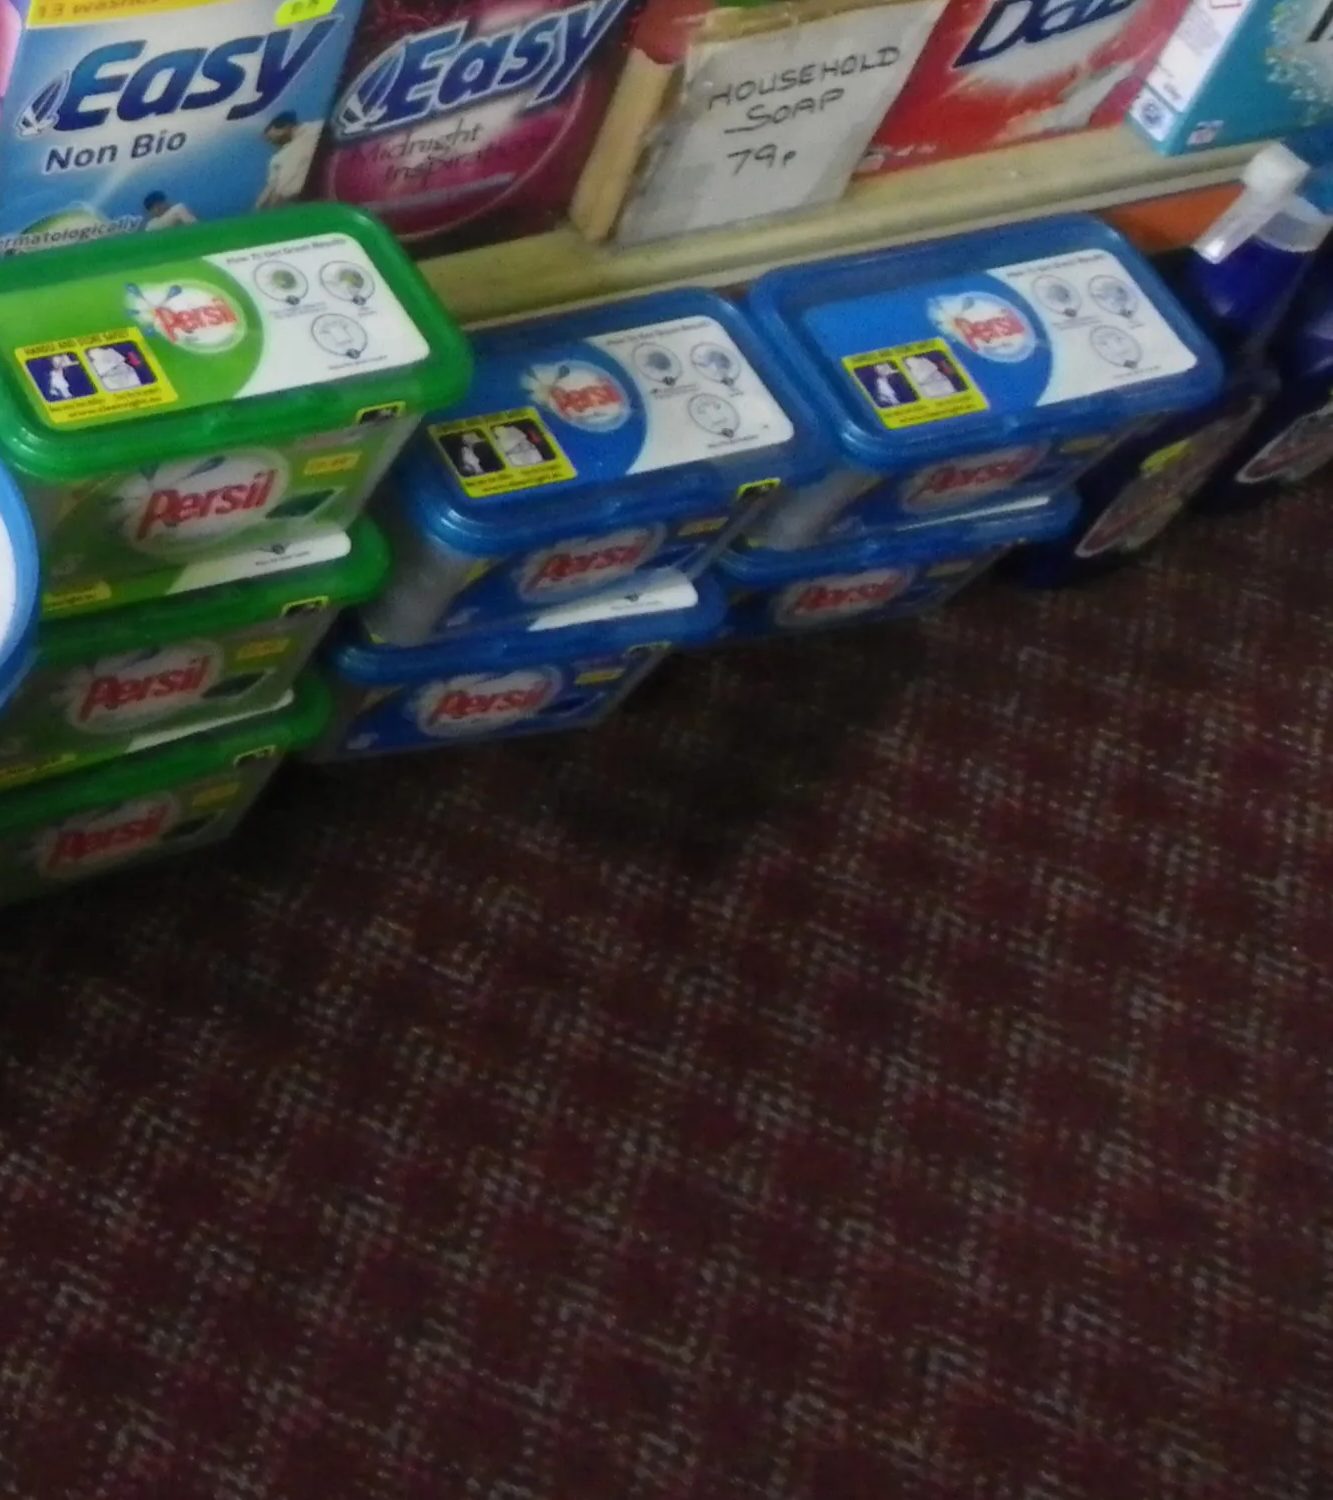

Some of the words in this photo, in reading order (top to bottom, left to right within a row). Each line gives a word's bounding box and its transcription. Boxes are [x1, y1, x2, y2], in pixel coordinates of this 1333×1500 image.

[38, 4, 64, 19] 13
[54, 14, 344, 132] Easy
[709, 46, 902, 111] HOUSEHOLD
[743, 88, 846, 131] SOAP
[44, 141, 118, 174] Non
[130, 130, 188, 159] Bio
[154, 294, 238, 344] Persil
[958, 310, 1025, 353] Persil
[546, 380, 619, 425] Persil
[922, 452, 1029, 498] Persil
[137, 470, 278, 540] Persil
[530, 537, 650, 592] Persil
[796, 571, 897, 619] Persil
[79, 654, 215, 710] Persil
[430, 672, 553, 726] Persil
[48, 809, 171, 863] Persil
